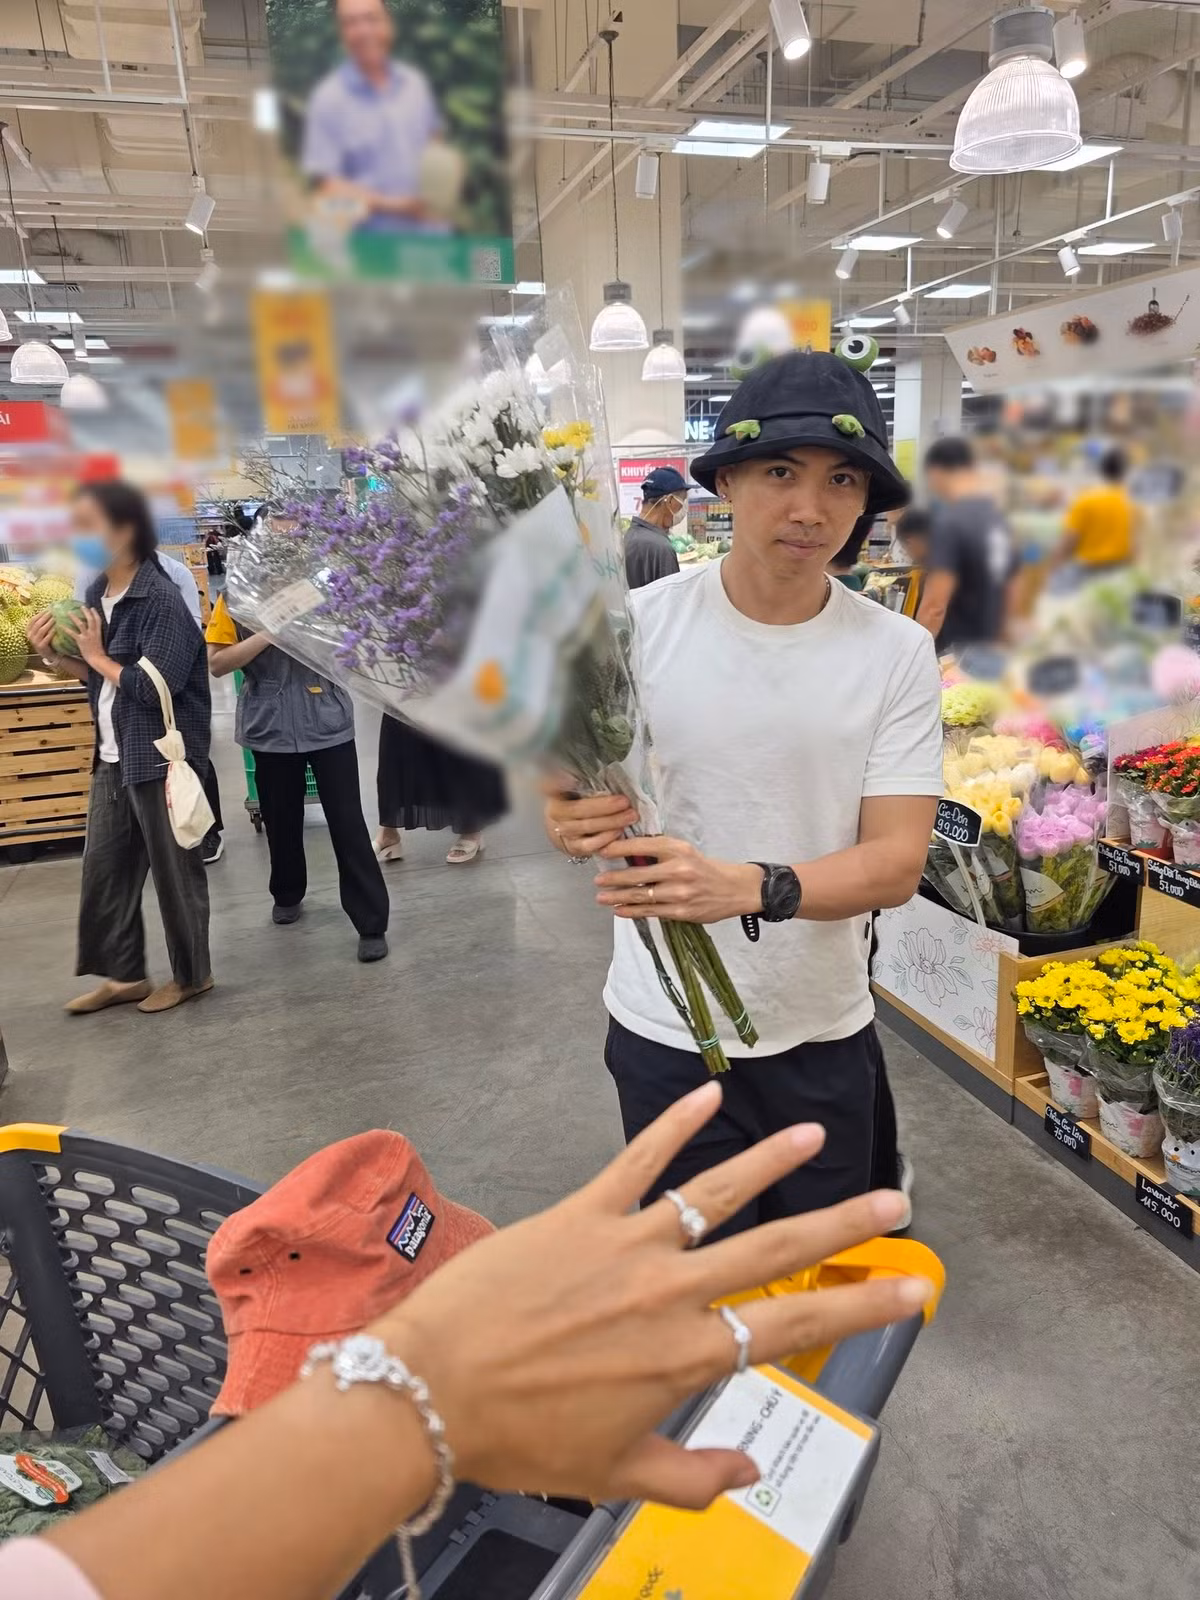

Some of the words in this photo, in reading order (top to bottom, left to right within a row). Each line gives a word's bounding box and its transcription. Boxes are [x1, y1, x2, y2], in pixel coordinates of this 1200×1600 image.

[937, 818, 969, 842] 99.000
[1159, 880, 1184, 897] 57.000
[1054, 1126, 1077, 1150] 75.000
[1140, 1195, 1181, 1228] 115.000
[404, 1210, 432, 1258] patagonia
[736, 1420, 763, 1452] RNING
